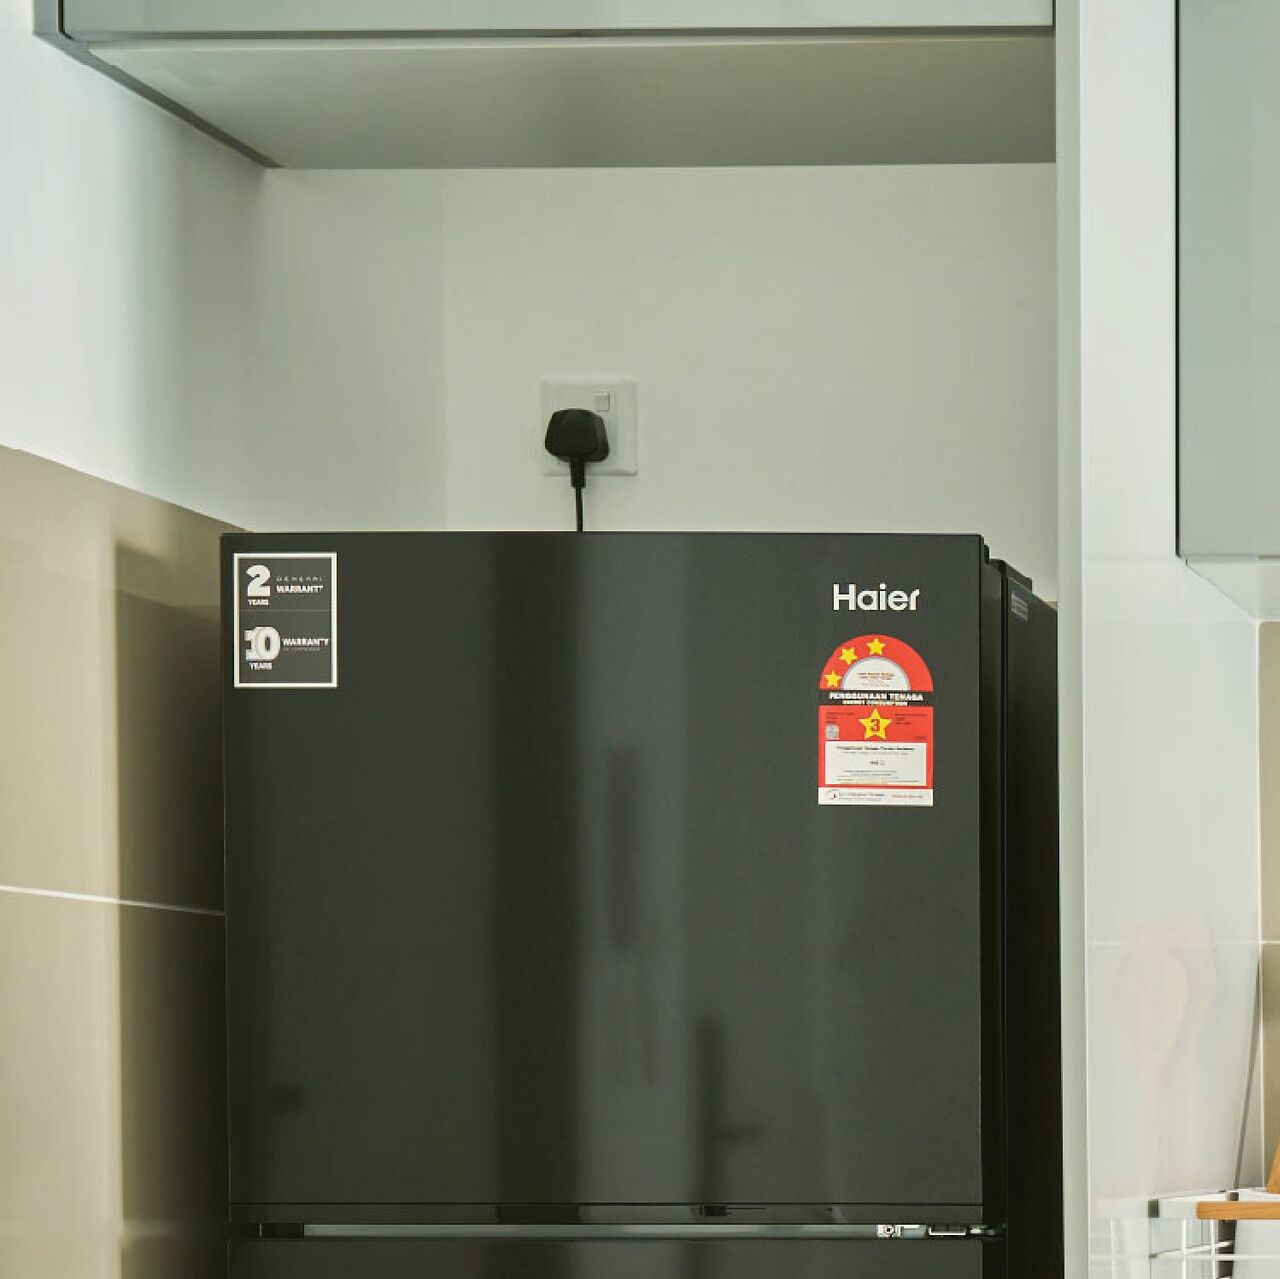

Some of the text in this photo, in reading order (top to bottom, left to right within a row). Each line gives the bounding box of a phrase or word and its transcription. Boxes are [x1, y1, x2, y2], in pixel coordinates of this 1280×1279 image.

[246, 565, 271, 597] 2
[833, 582, 920, 611] Haier
[244, 626, 281, 661] 10
